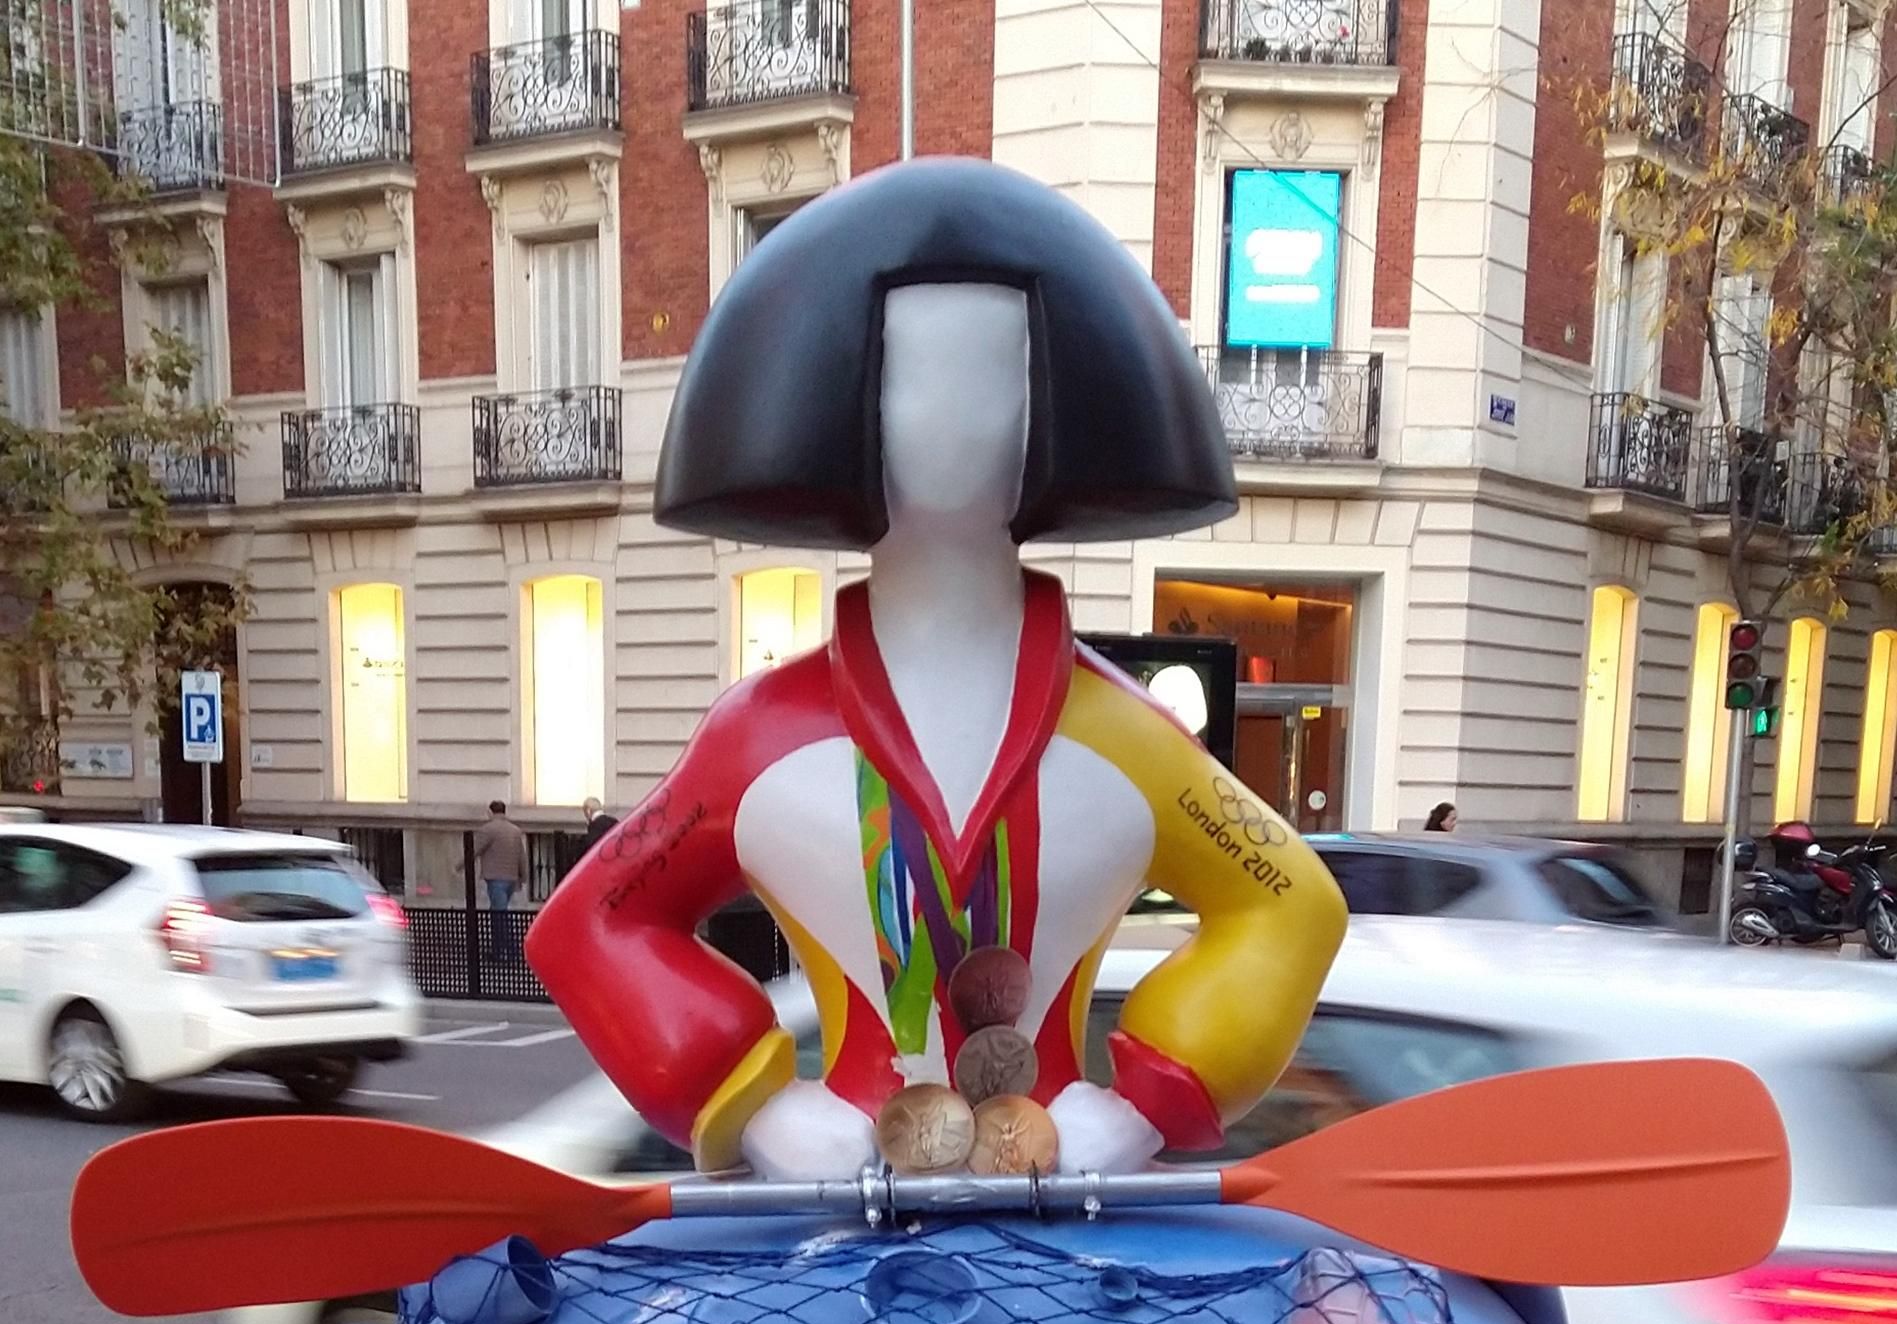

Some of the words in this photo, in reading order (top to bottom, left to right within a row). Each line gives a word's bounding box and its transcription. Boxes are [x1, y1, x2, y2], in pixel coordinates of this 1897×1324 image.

[190, 696, 211, 740] P
[1178, 788, 1242, 859] London
[1242, 851, 1293, 897] 2012
